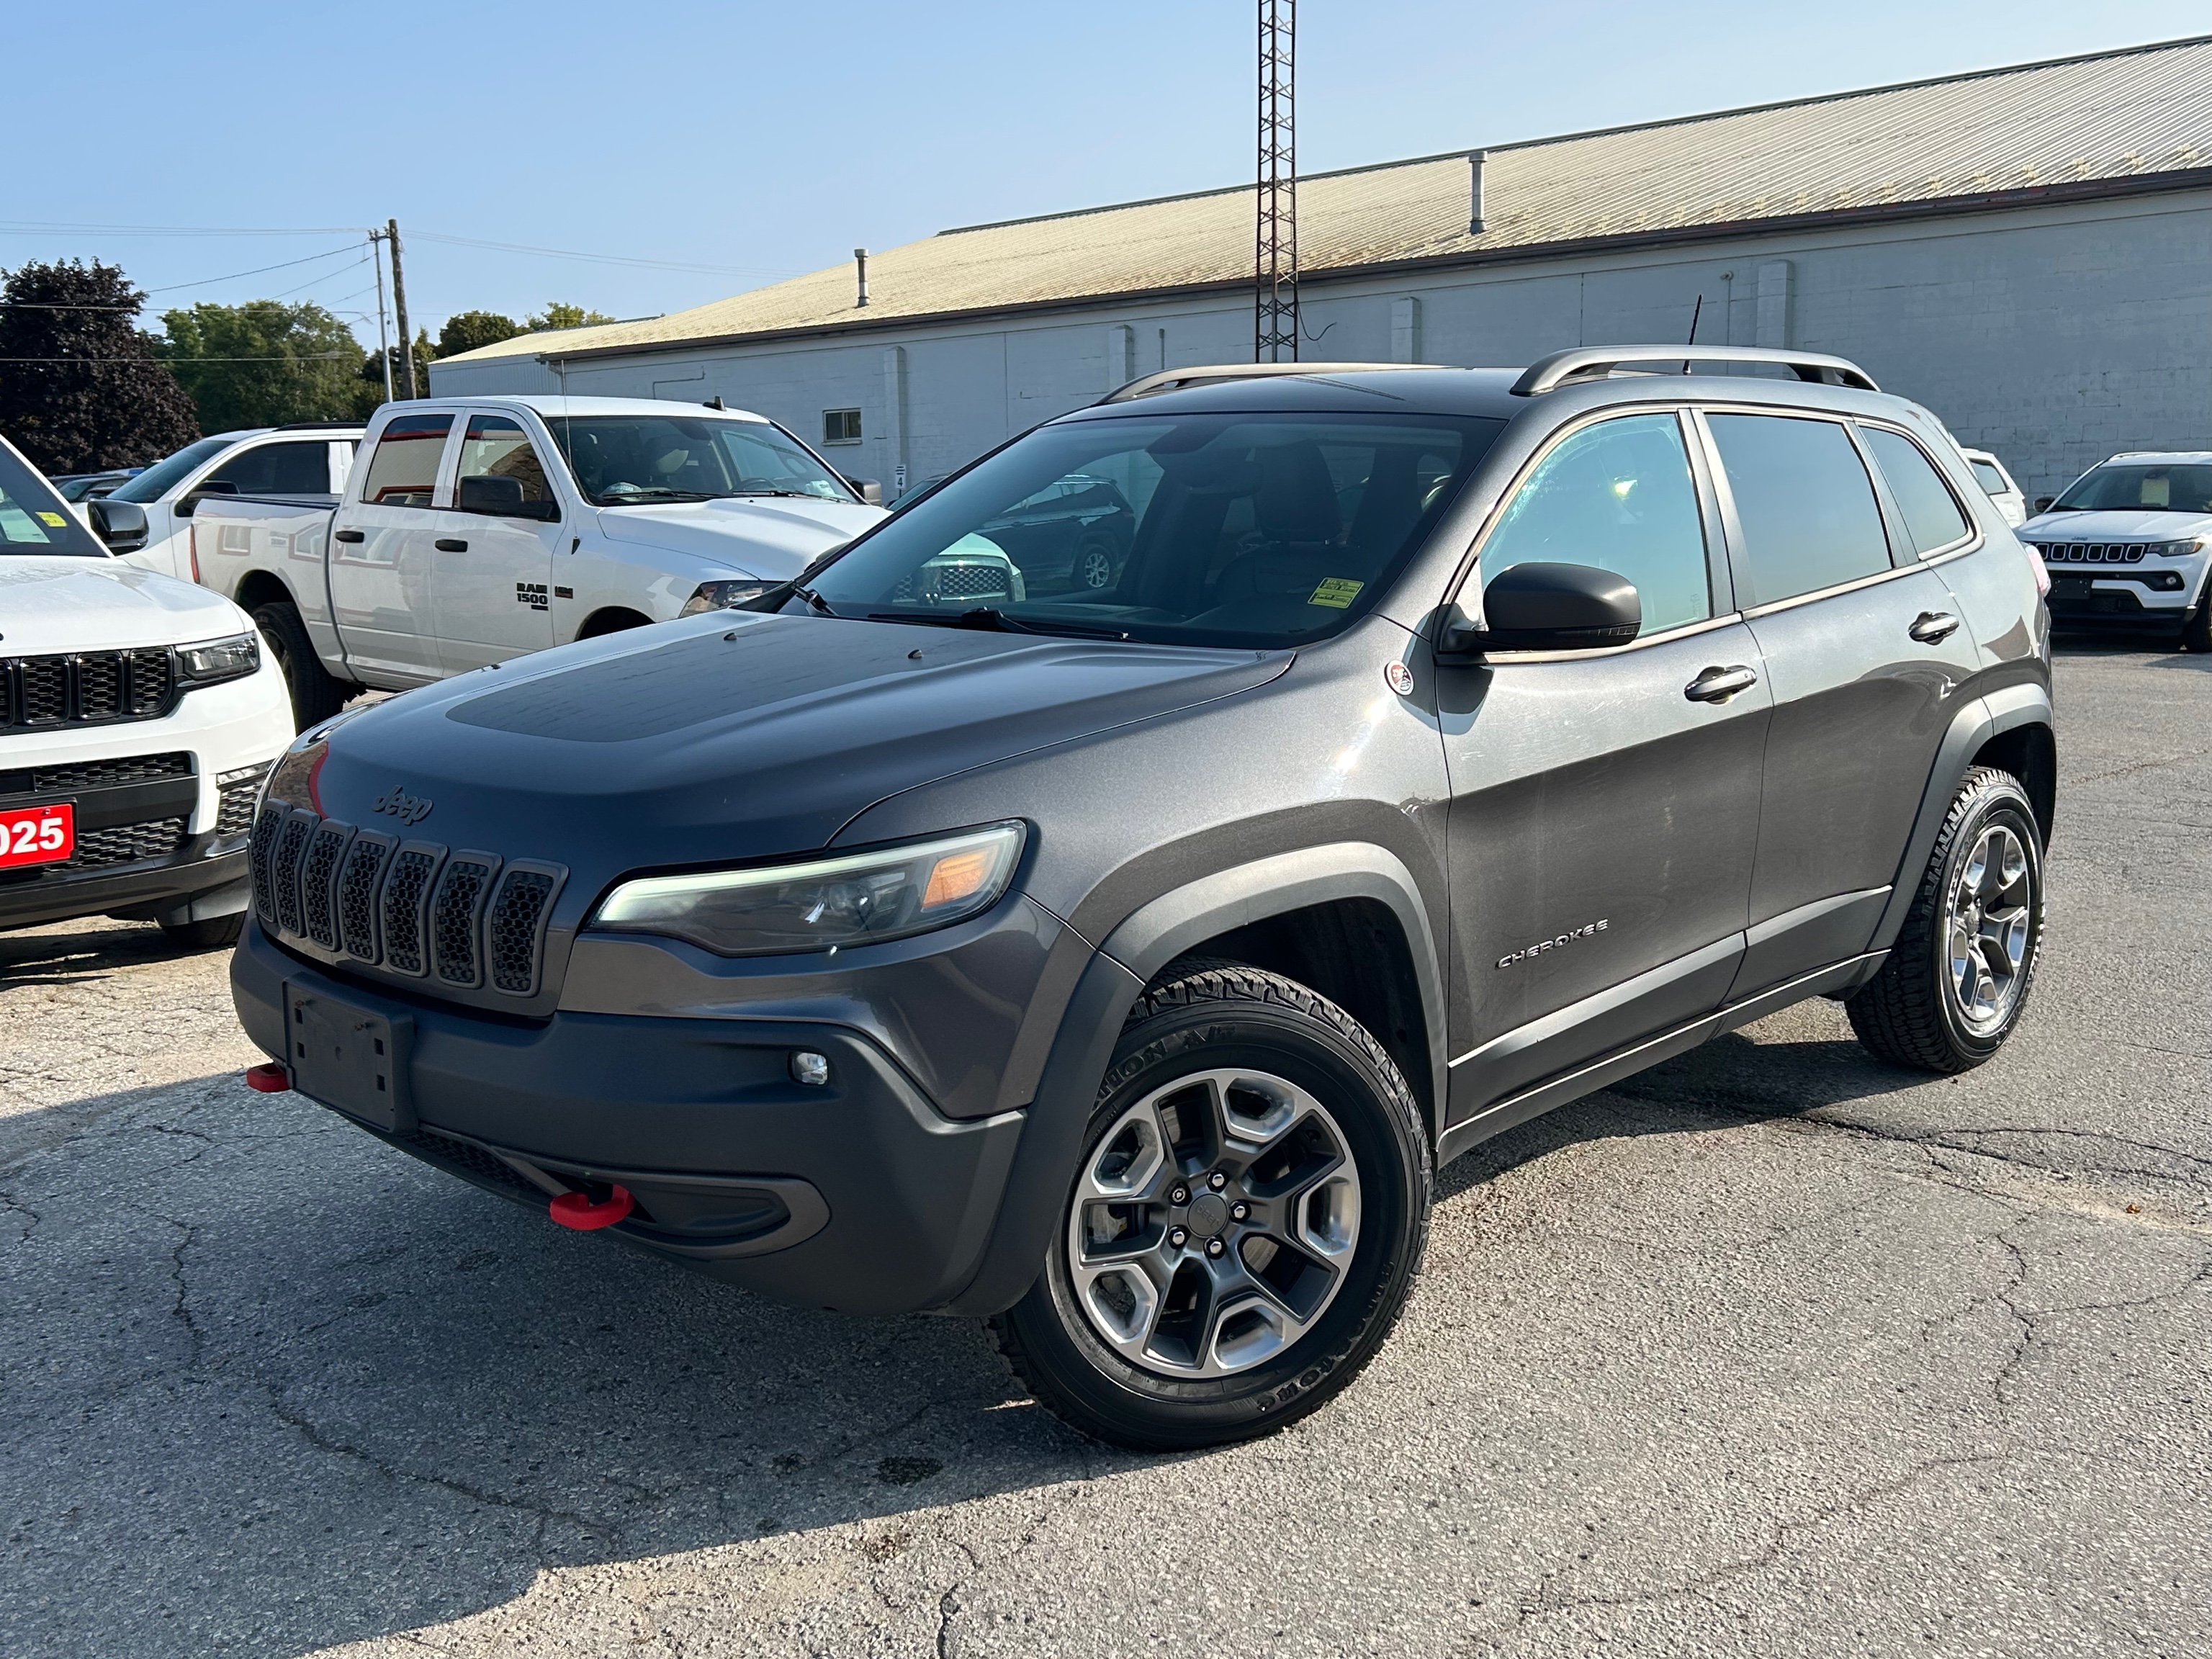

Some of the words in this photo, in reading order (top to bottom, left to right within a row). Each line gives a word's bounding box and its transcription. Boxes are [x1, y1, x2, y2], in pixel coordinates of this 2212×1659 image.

[897, 477, 903, 487] 4
[516, 583, 547, 594] RAM
[517, 593, 548, 605] 1500
[372, 784, 434, 826] Jeep
[1496, 918, 1609, 969] CHEROKEE
[1195, 1204, 1220, 1228] Jeep
